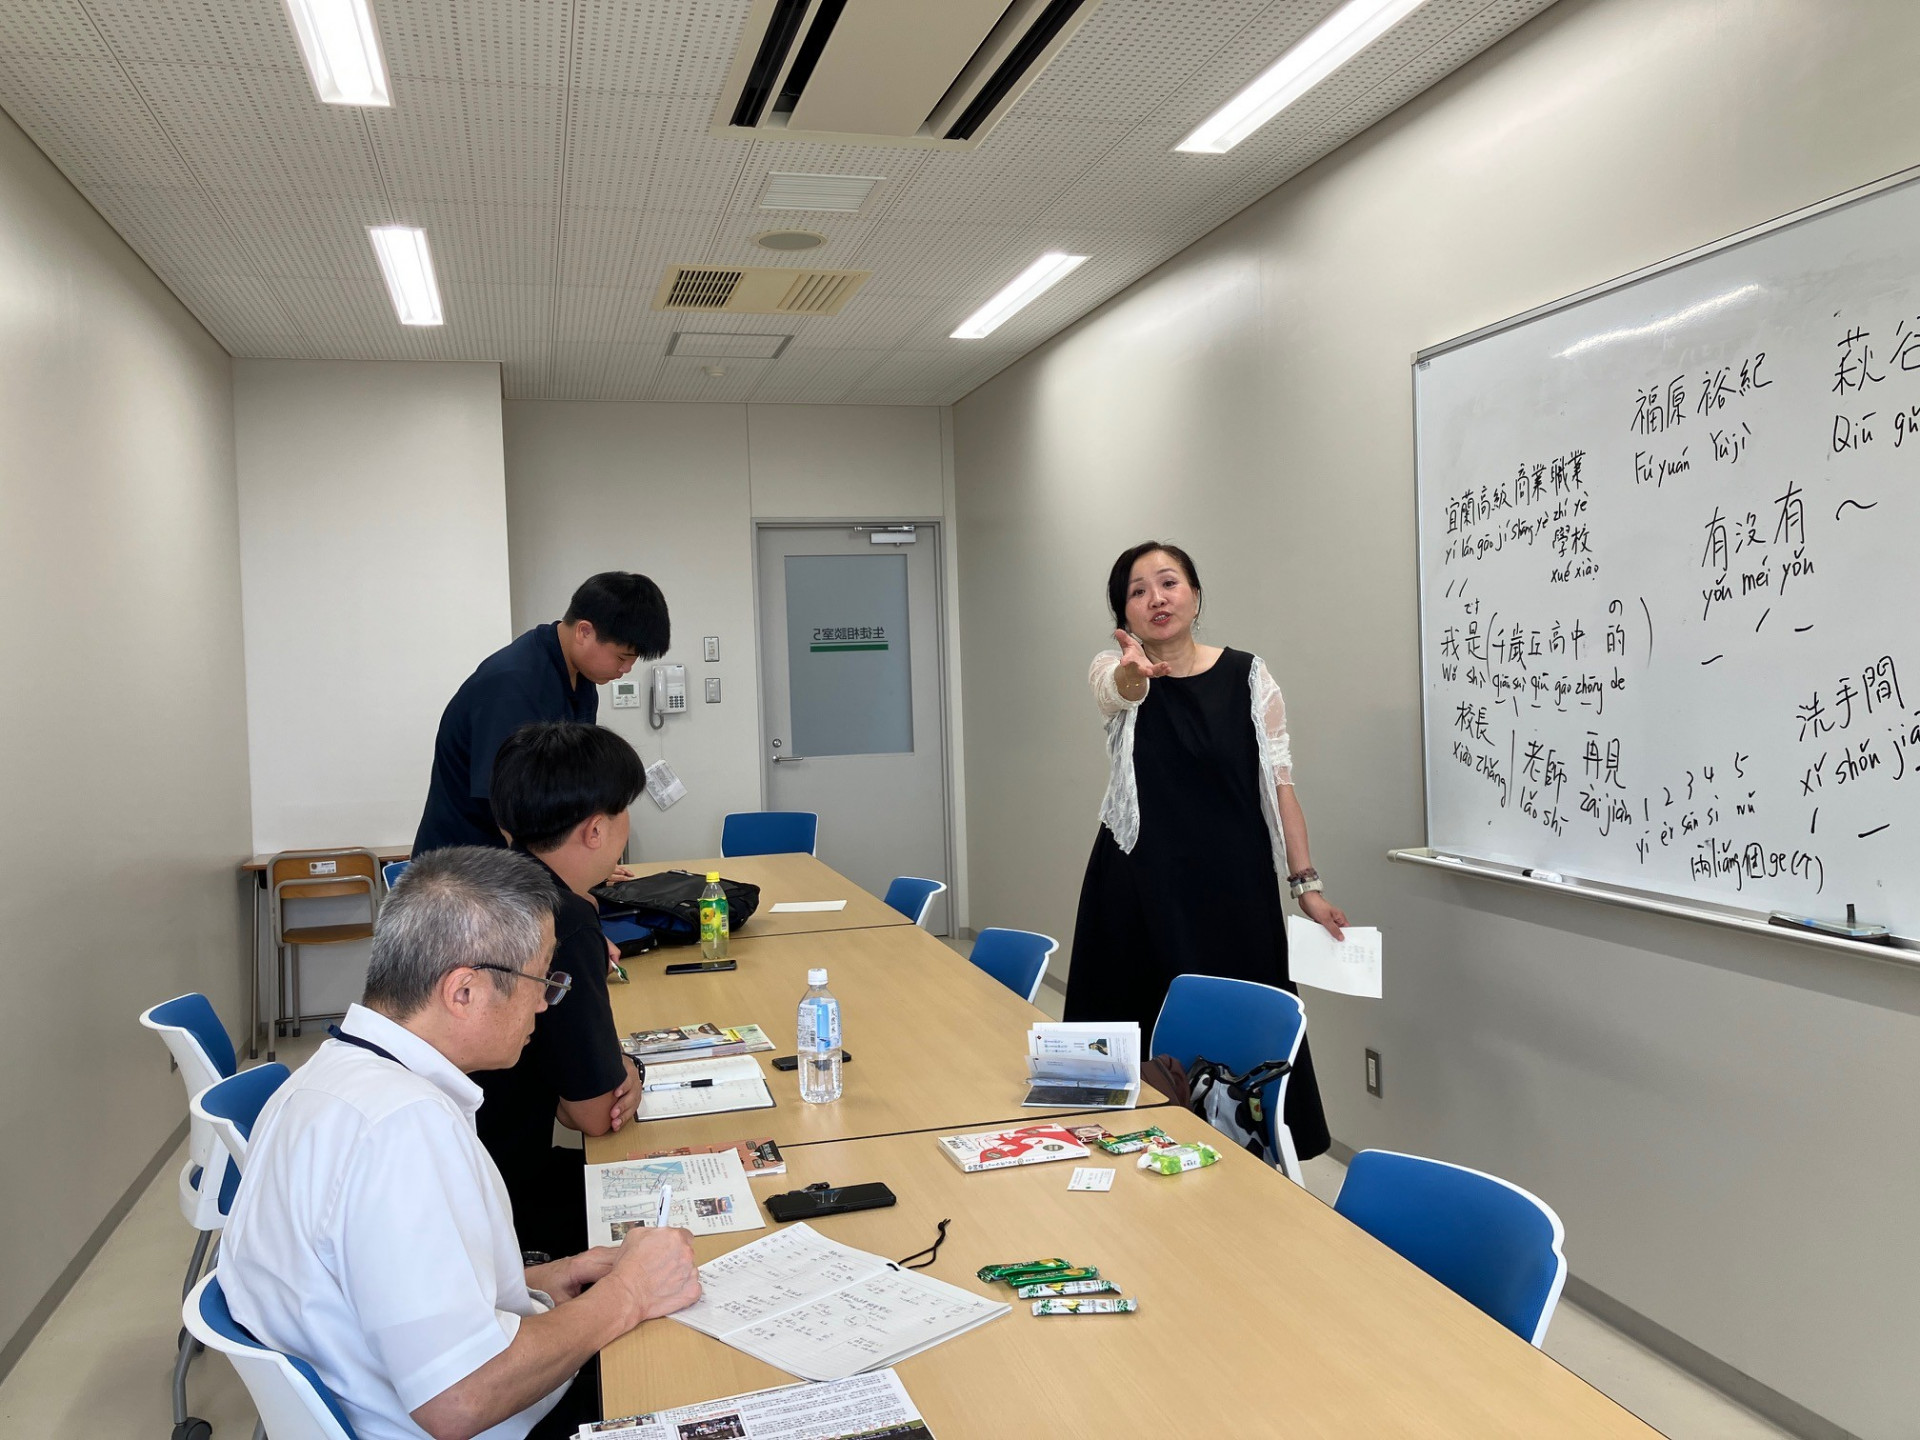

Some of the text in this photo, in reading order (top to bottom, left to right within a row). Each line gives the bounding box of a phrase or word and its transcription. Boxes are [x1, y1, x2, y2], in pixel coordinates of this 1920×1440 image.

[1631, 374, 1687, 435] 福原
[1552, 523, 1593, 557] 學校
[1454, 700, 1496, 747] 校長
[1522, 730, 1627, 805] 老師 再見
[1662, 786, 1674, 807] 2
[1685, 770, 1695, 801] 3
[1703, 765, 1715, 784] 4
[1734, 751, 1749, 779] 5
